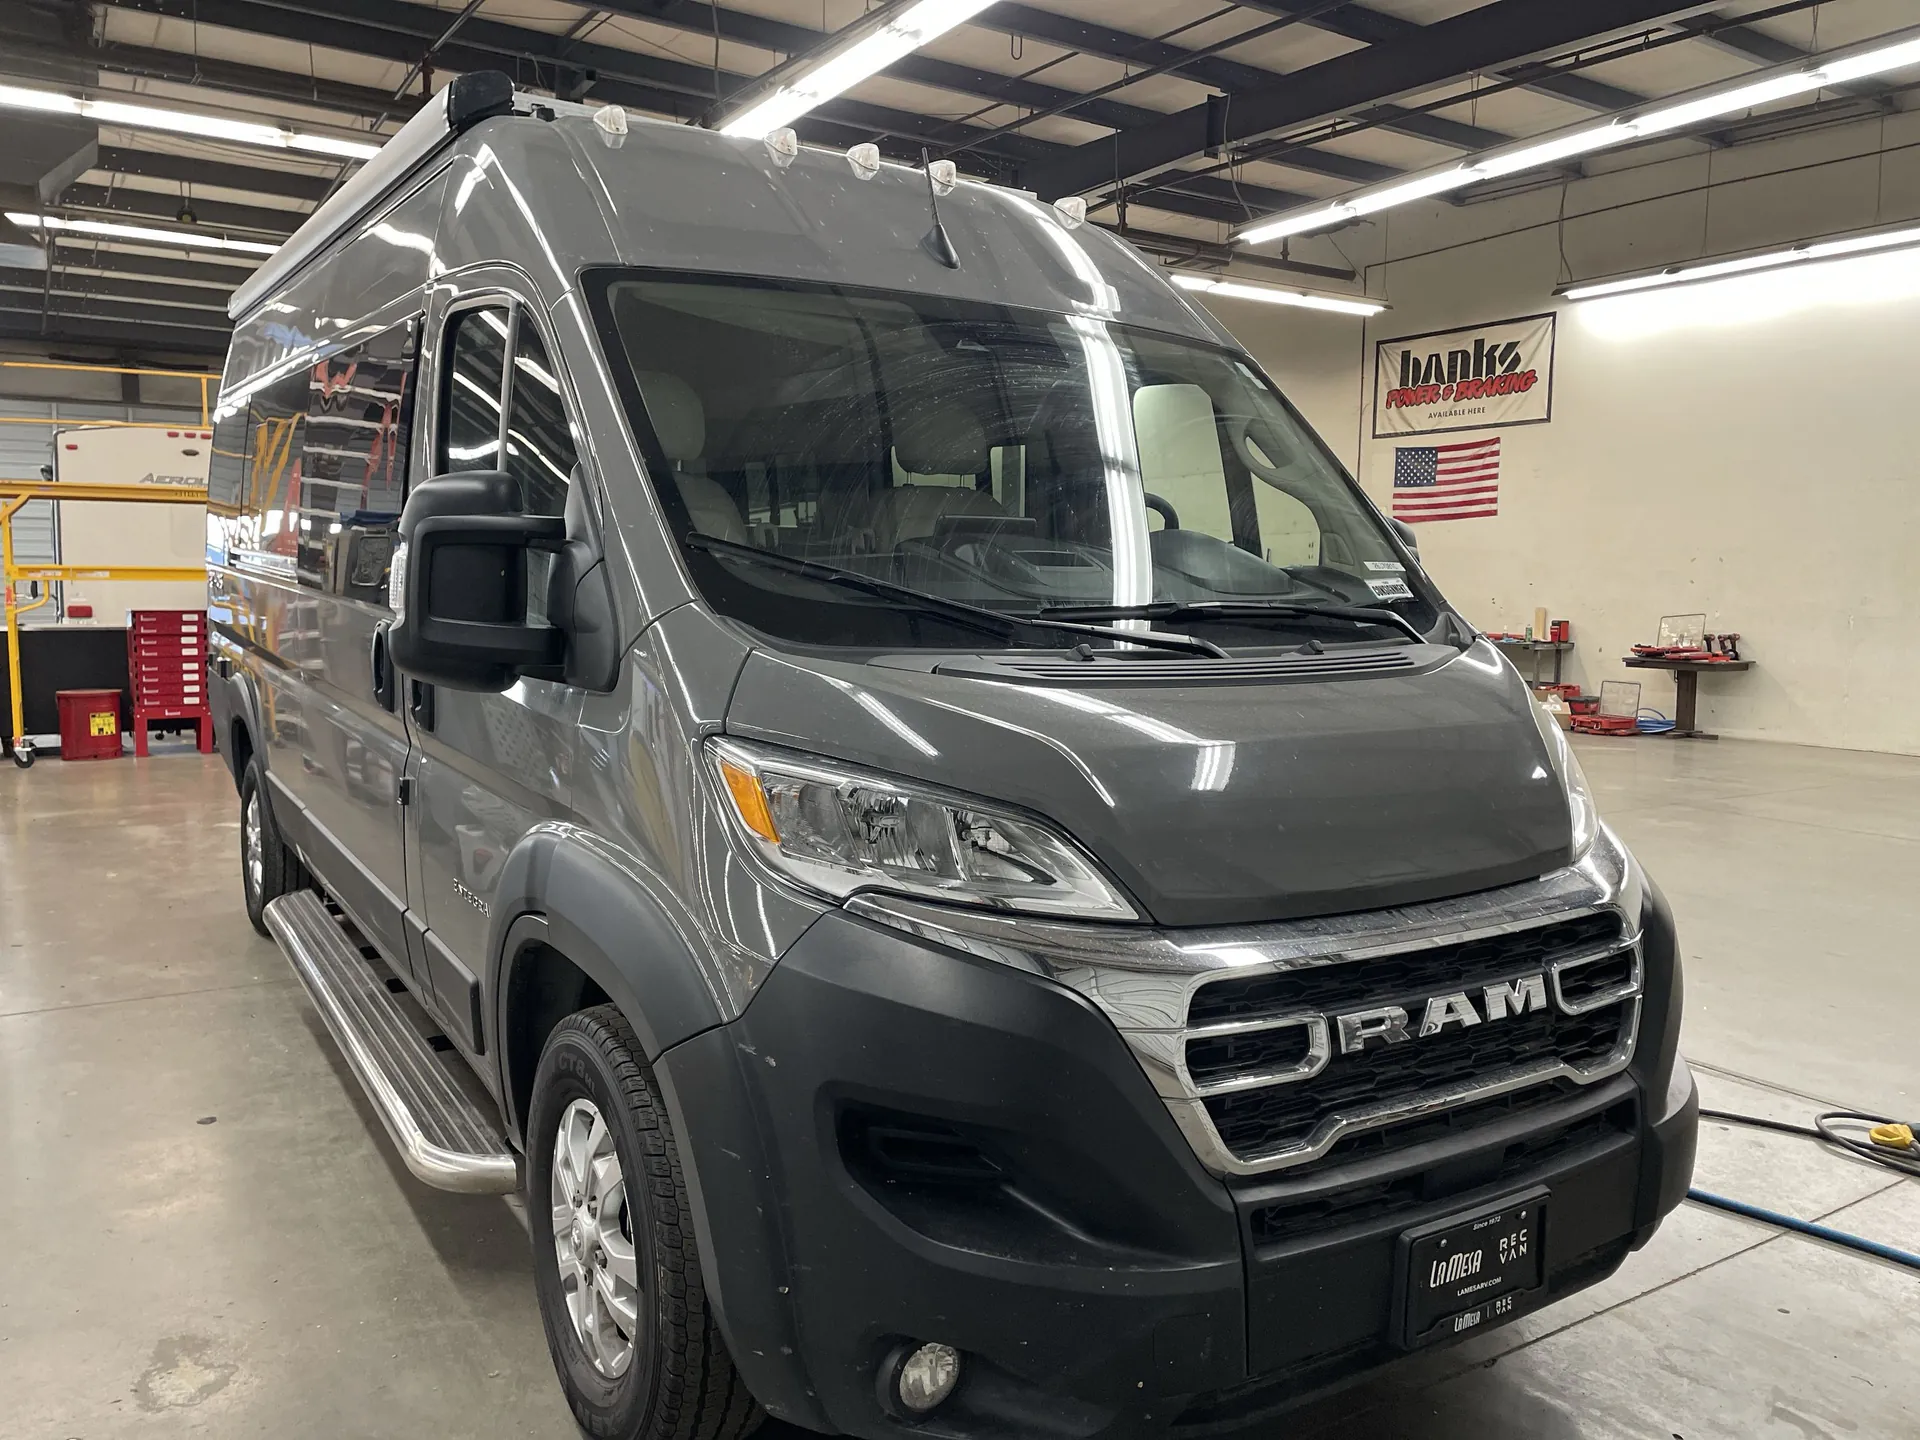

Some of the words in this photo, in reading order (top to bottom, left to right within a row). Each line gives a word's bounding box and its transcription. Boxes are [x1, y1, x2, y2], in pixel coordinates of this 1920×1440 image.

[1400, 338, 1522, 388] banks
[1385, 382, 1441, 409] POWER
[1442, 385, 1454, 401] &
[1453, 369, 1538, 402] BRAKING
[1428, 408, 1466, 419] AVAILABLE
[1467, 406, 1486, 416] HERE
[1337, 974, 1547, 1054] RAM
[1473, 1221, 1488, 1231] Since
[1500, 1228, 1528, 1251] REC
[1500, 1242, 1527, 1265] VAN
[1457, 1276, 1502, 1297] LAMESARV.COM
